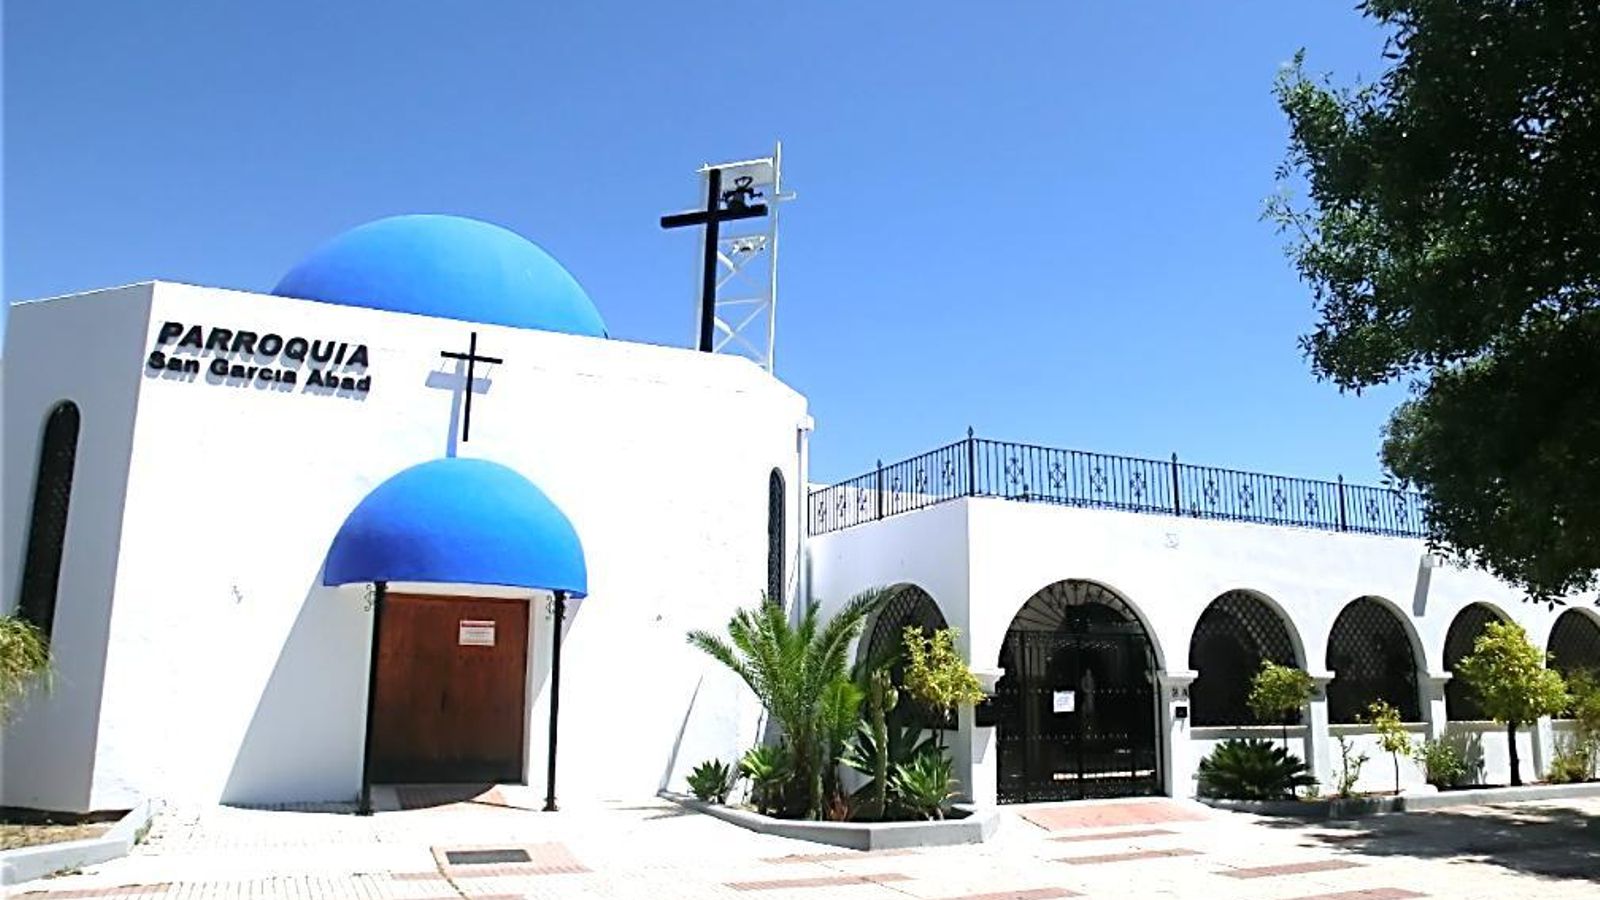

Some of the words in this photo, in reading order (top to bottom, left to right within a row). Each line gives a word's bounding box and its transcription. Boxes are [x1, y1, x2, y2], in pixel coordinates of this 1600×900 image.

[157, 321, 369, 368] PARROQUIA
[149, 350, 200, 374] San
[305, 369, 372, 392] Abad
